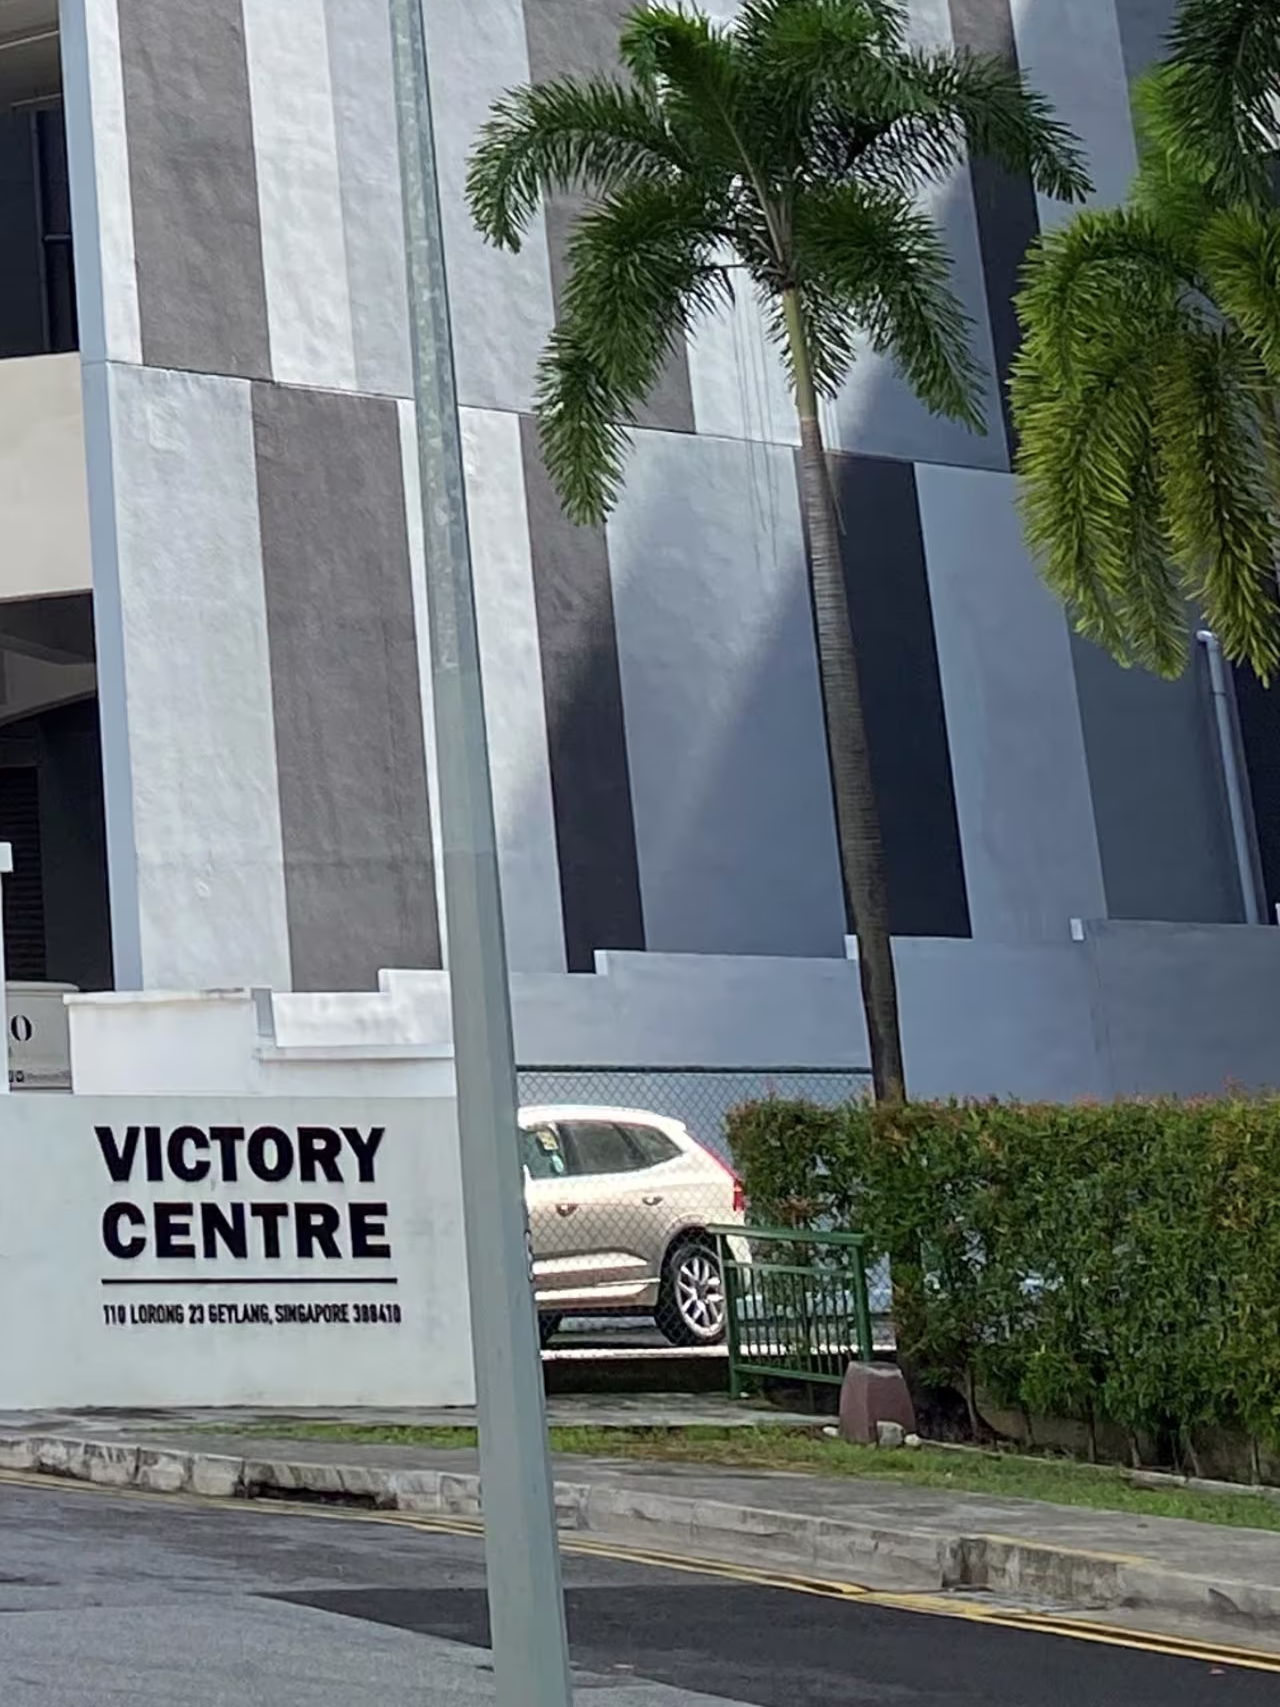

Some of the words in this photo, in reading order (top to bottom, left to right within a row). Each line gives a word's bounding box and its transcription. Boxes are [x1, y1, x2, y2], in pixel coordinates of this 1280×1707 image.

[95, 1125, 387, 1184] VICTORY
[101, 1201, 392, 1261] CENTRE
[103, 1304, 126, 1325] 110
[130, 1304, 185, 1324] LORONG
[189, 1304, 205, 1325] 23
[208, 1304, 273, 1326] GEYLANG,
[274, 1303, 350, 1325] SINGAPORE
